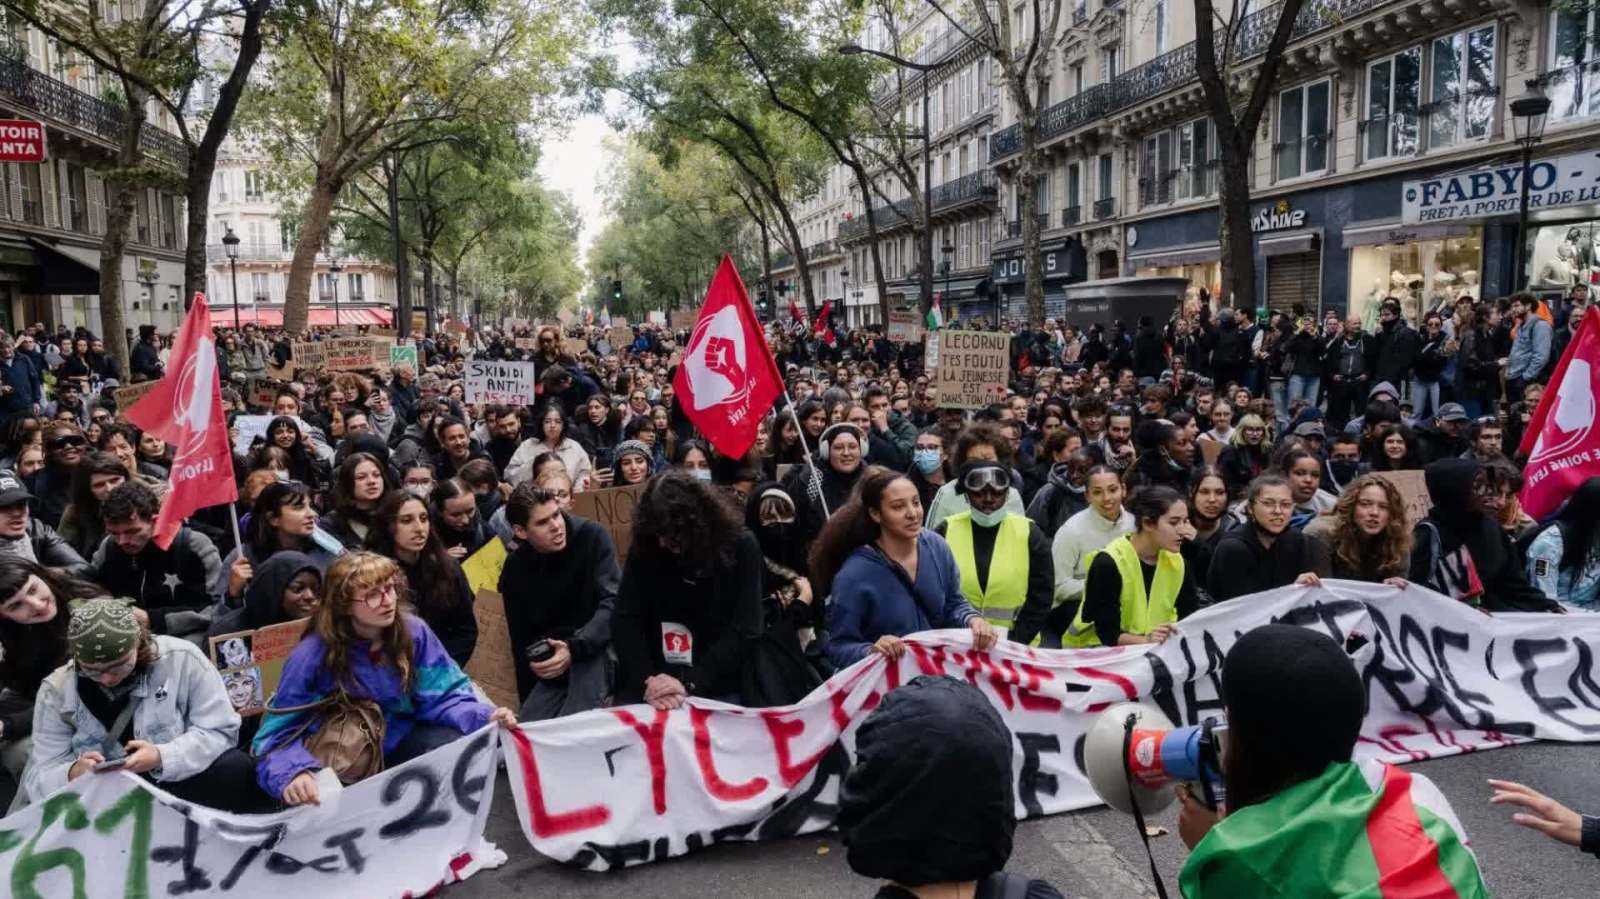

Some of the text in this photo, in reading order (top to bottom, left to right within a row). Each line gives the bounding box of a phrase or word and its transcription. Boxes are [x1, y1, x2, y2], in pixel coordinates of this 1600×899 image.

[1419, 162, 1557, 207] FABYO
[1418, 206, 1458, 222] PRET
[1474, 195, 1542, 214] PORTR
[1546, 189, 1574, 206] DE
[1000, 253, 1056, 277] JOS
[945, 332, 1005, 350] LECORNU
[964, 354, 1003, 369] FOUTU
[471, 364, 524, 378] SKIBIDI
[943, 369, 1004, 384] LA JEUNESSE
[487, 379, 518, 393] ANTI
[962, 383, 982, 393] EST
[941, 392, 962, 404] DANS
[965, 394, 983, 405] TON
